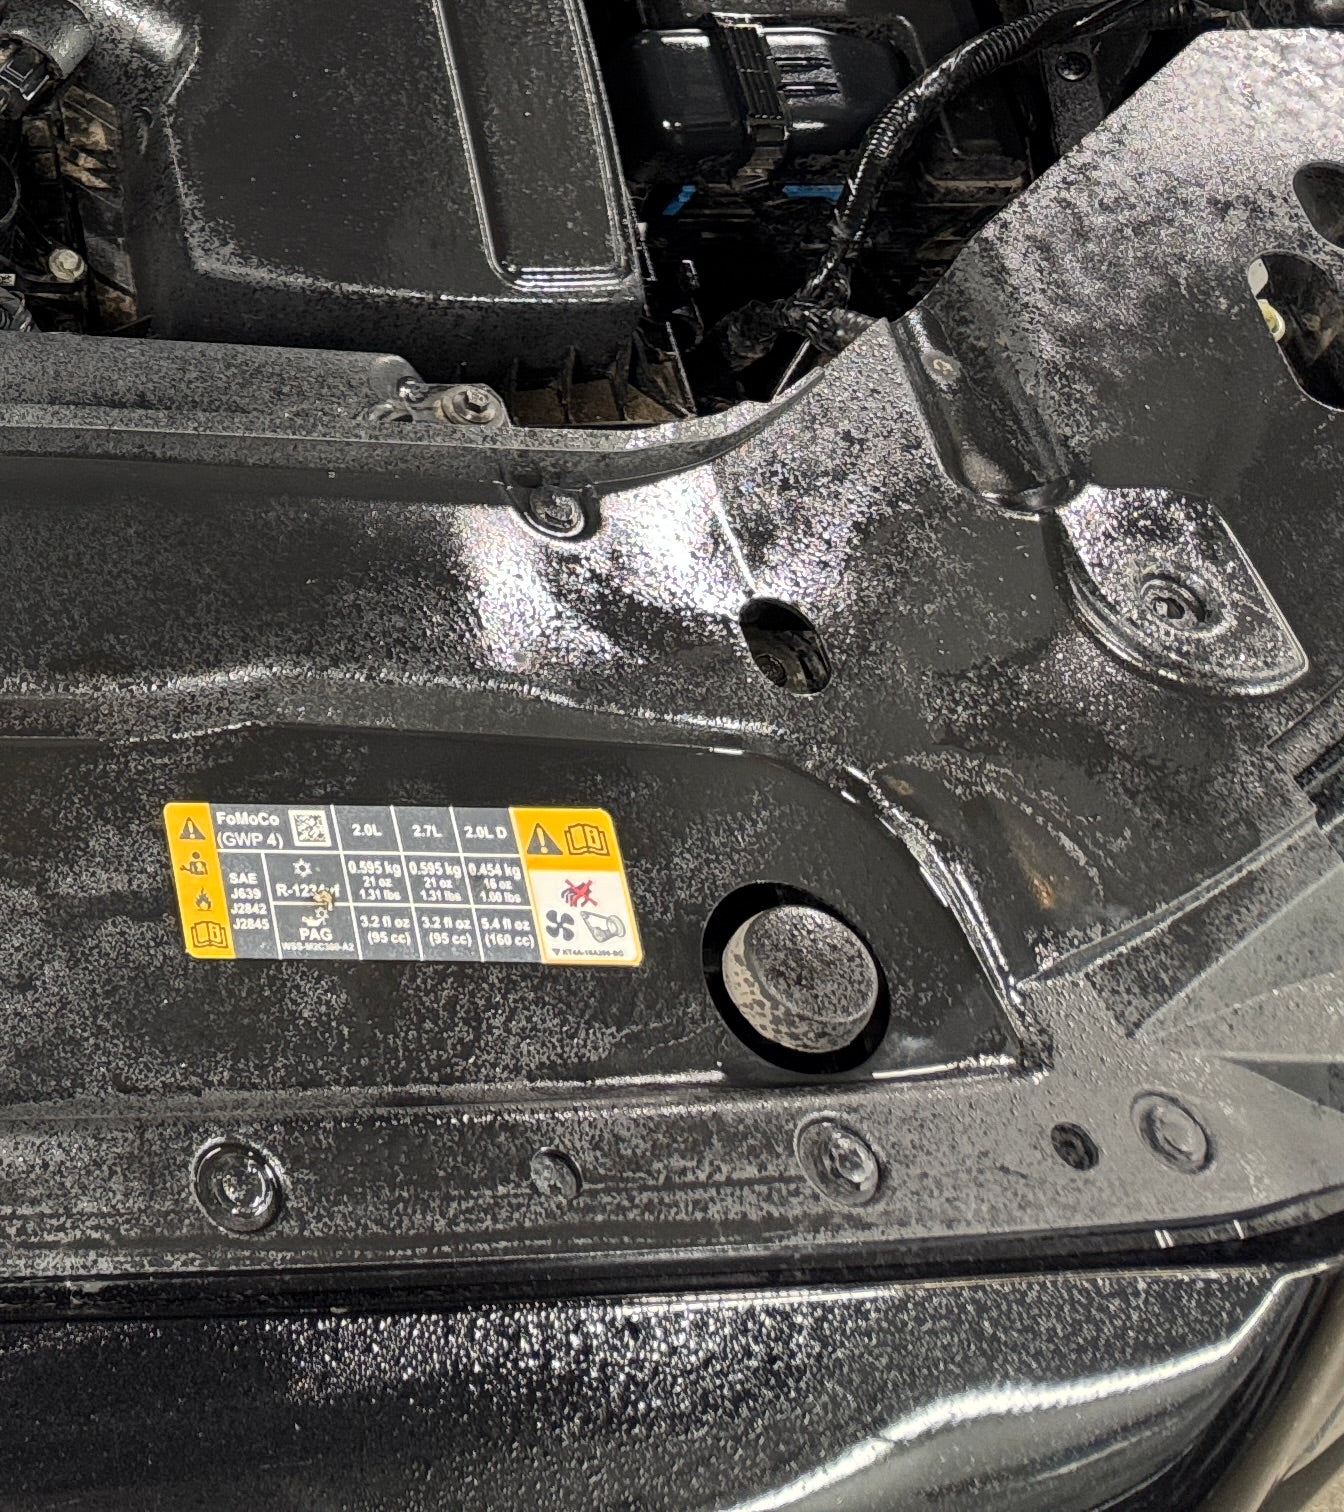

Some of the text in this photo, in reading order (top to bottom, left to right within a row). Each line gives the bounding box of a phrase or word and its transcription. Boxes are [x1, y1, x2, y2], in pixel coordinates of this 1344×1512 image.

[215, 811, 280, 826] FoMoCo
[351, 823, 383, 837] 2.0L
[412, 824, 443, 838] 2.7L
[464, 826, 508, 839] 2.0L D
[217, 832, 285, 849] (GWP 4)
[348, 861, 402, 878] 0.595 kg
[409, 862, 462, 879] 0.595 kg
[467, 863, 522, 880] 0.454 kg
[228, 872, 258, 885] SAE
[362, 876, 393, 888] 21 oz
[423, 877, 454, 889] 21 oz
[498, 880, 513, 890] oz
[230, 887, 262, 900] J639
[359, 889, 402, 901] 1.31 lbs
[420, 890, 462, 902] 1.31 lbs
[503, 892, 522, 903] lbs
[231, 902, 268, 915] J2842
[233, 918, 270, 931] J2845
[360, 915, 411, 929] 3.2 fl oz
[421, 916, 472, 930] 3.2 fl oz
[481, 917, 500, 930] 5.4
[515, 920, 531, 930] oz
[299, 928, 333, 942] PAG
[367, 931, 411, 947] (95 cc)
[428, 933, 473, 948] (95 cc)
[483, 934, 535, 949] (160 cc)
